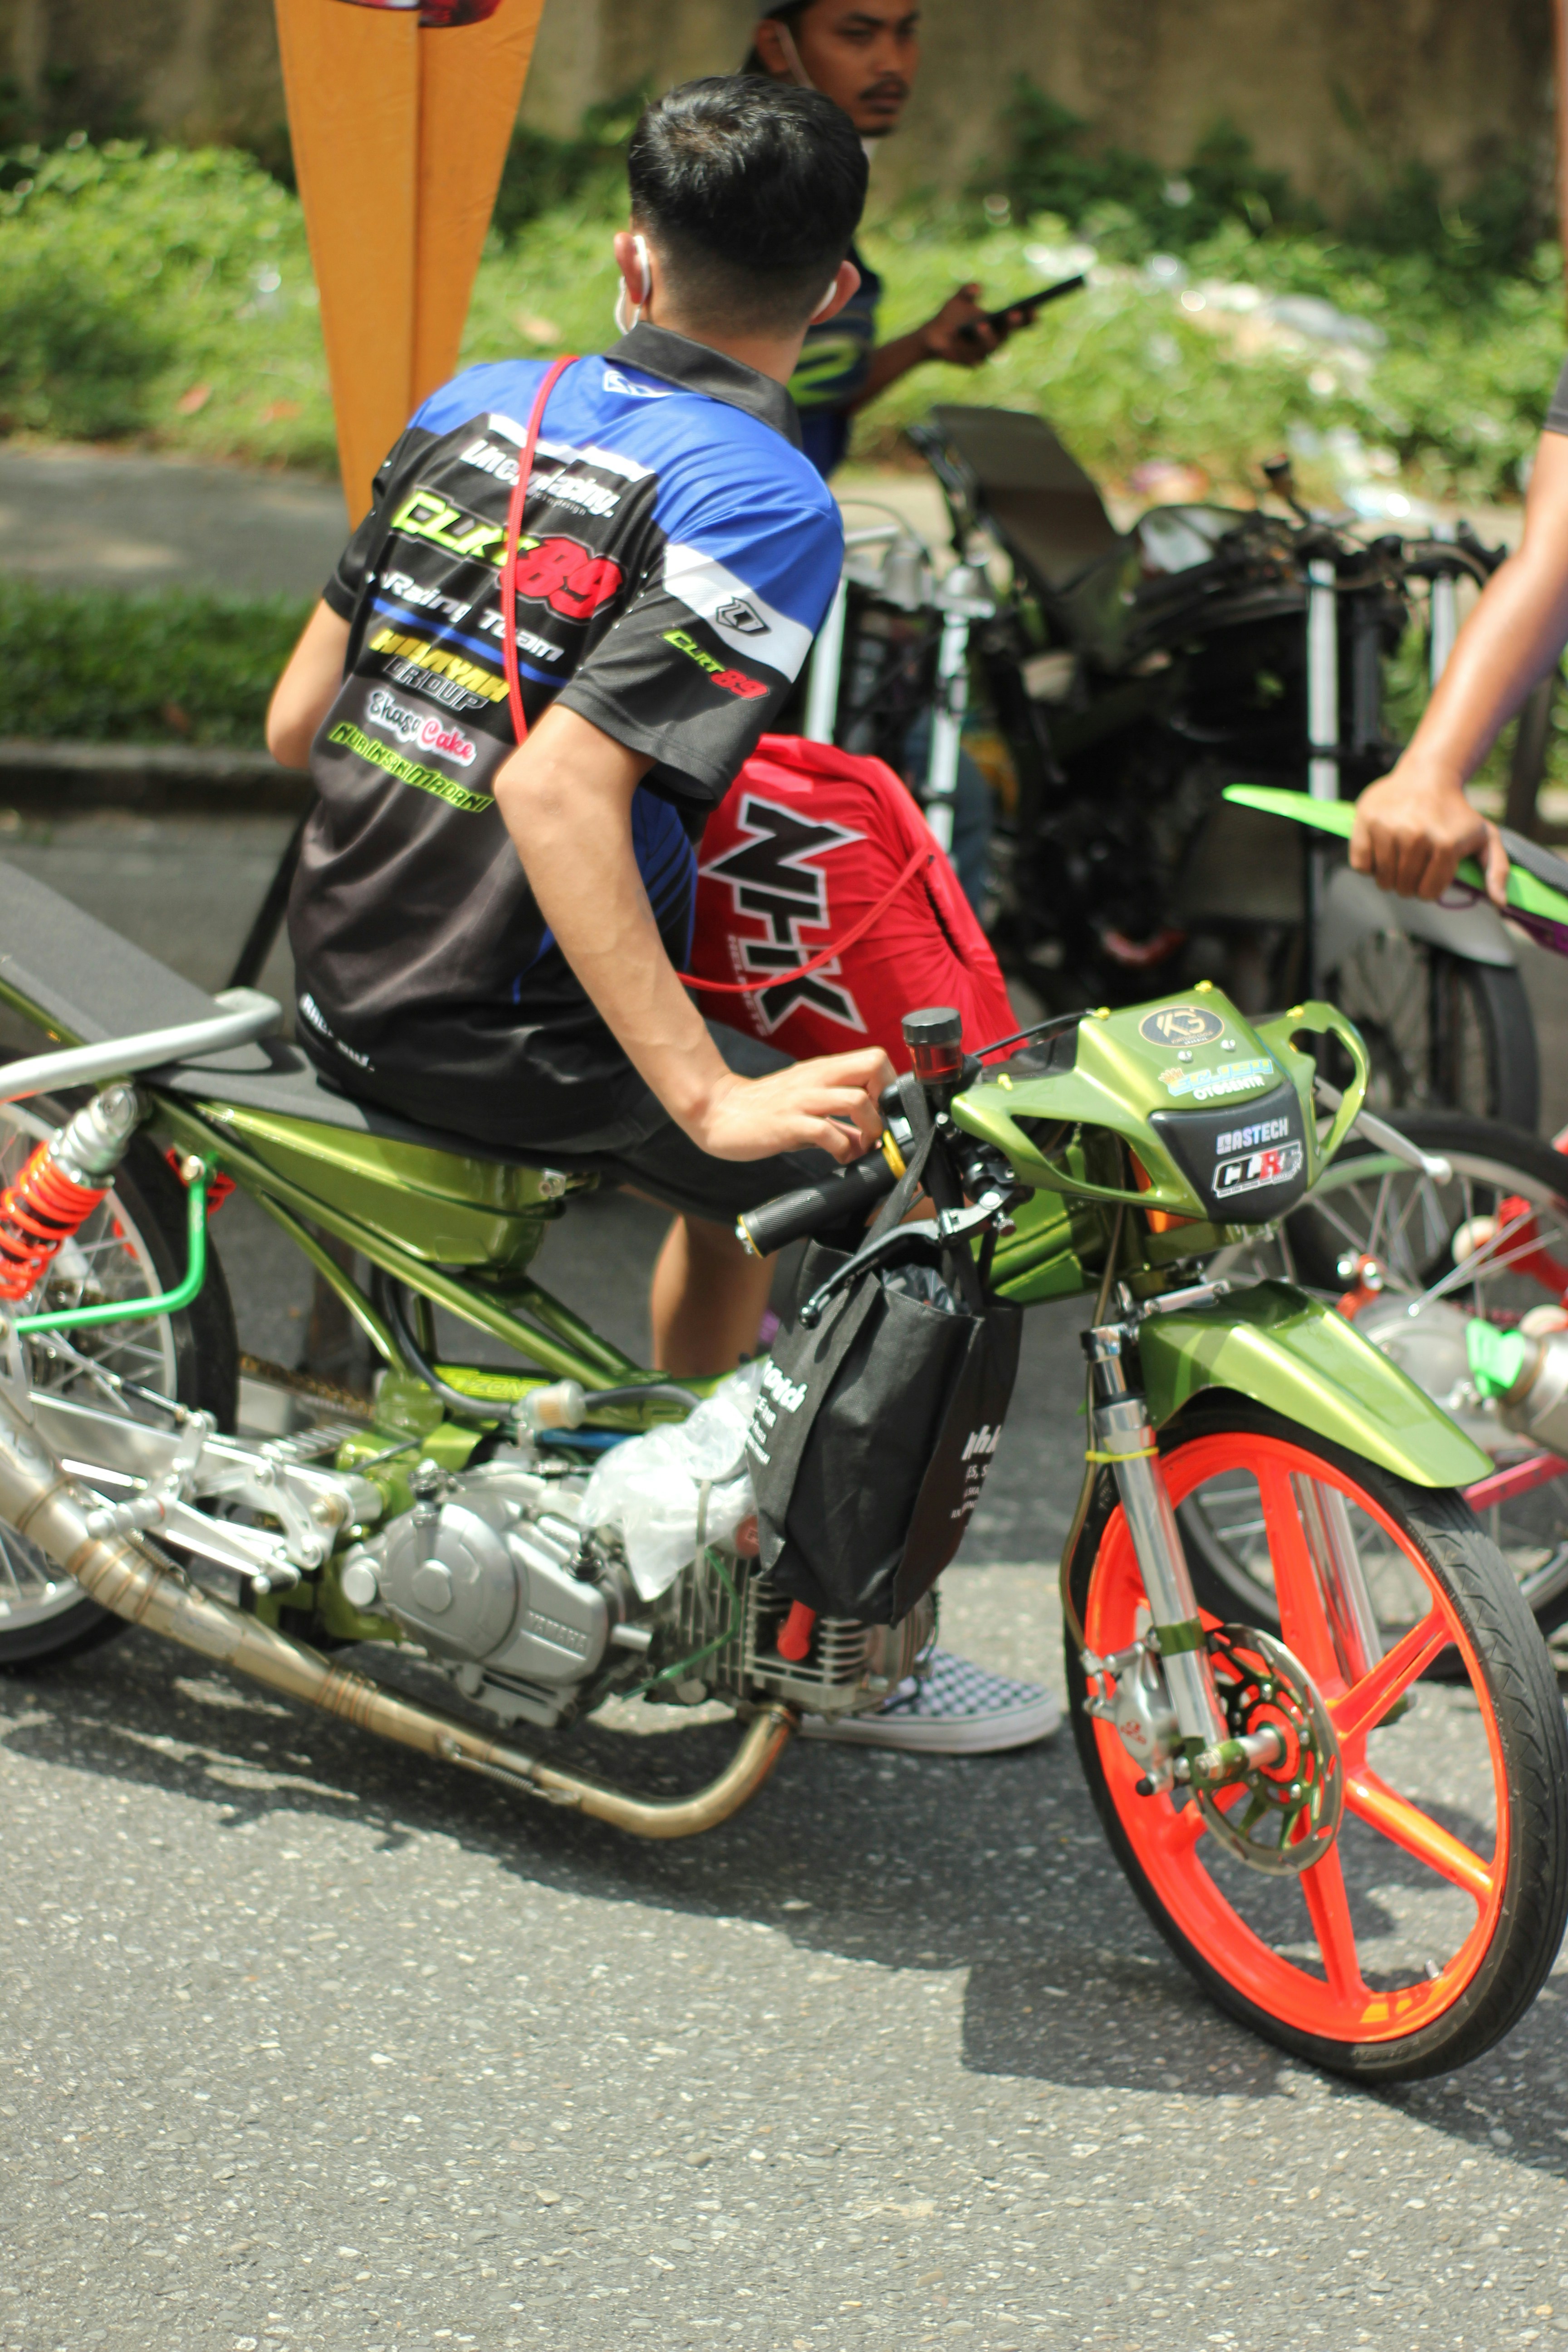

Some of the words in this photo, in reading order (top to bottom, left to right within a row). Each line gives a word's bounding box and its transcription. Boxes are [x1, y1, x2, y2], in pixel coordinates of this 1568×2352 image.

[382, 656, 490, 711] GROUP
[662, 629, 725, 673] CLRT
[710, 668, 769, 700] 89
[697, 793, 867, 1034] NHK
